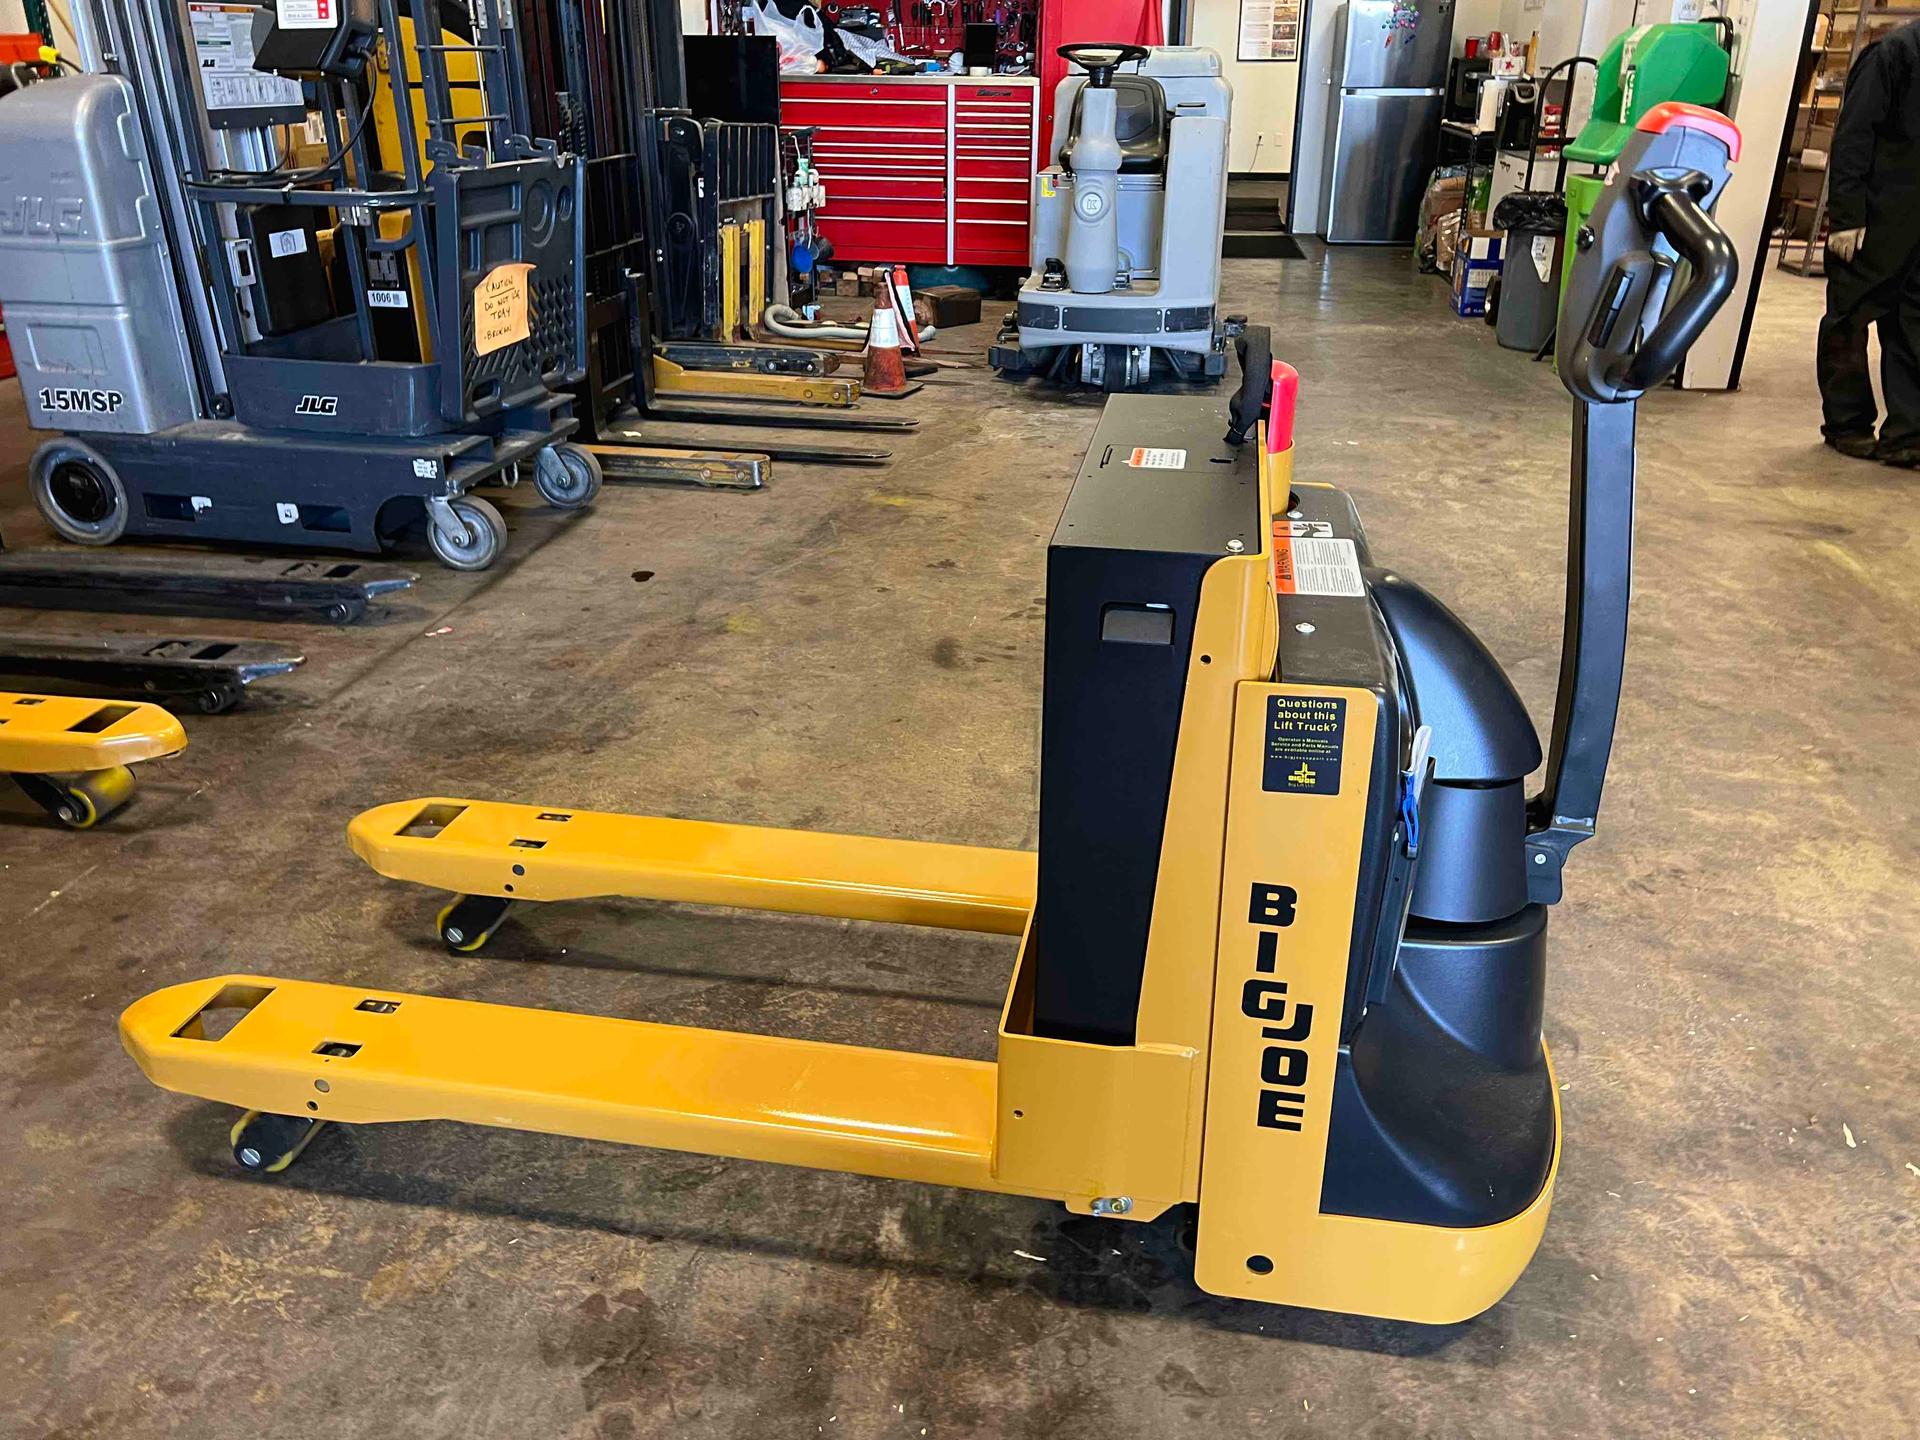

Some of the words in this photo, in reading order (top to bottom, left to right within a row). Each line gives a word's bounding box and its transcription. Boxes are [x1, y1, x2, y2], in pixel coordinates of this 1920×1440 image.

[40, 387, 123, 412] 15MSP
[295, 395, 338, 415] JLG
[1276, 548, 1290, 574] WARNING
[1277, 699, 1338, 709] Questions
[1277, 711, 1311, 719] about
[1314, 712, 1336, 720] this
[1274, 721, 1293, 730] Lift
[1297, 722, 1338, 731] Truck?
